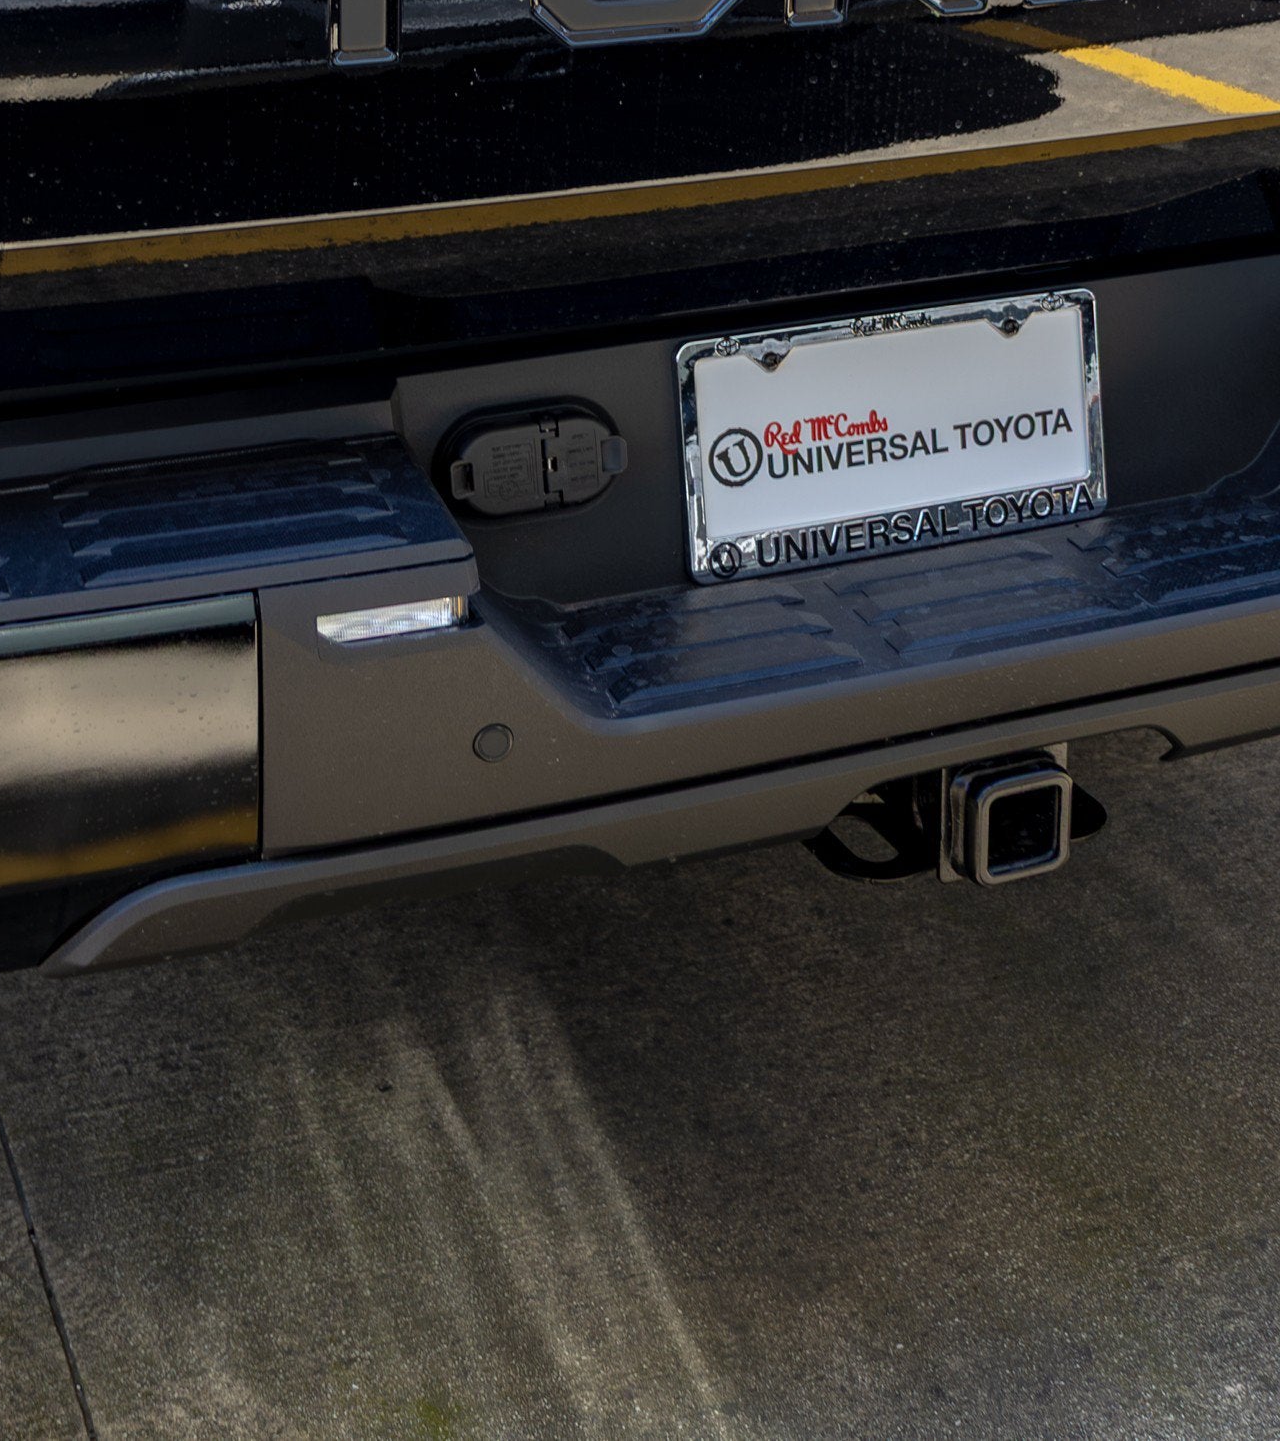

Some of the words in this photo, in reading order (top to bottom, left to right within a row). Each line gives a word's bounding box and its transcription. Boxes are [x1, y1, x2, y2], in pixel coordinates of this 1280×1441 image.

[764, 421, 802, 454] Red
[803, 409, 889, 441] McCombs
[767, 428, 949, 479] UNIVERSAL
[953, 408, 1073, 450] TOYOTA
[755, 505, 960, 567] UNIVERSAL
[962, 482, 1095, 532] TOYOTA
